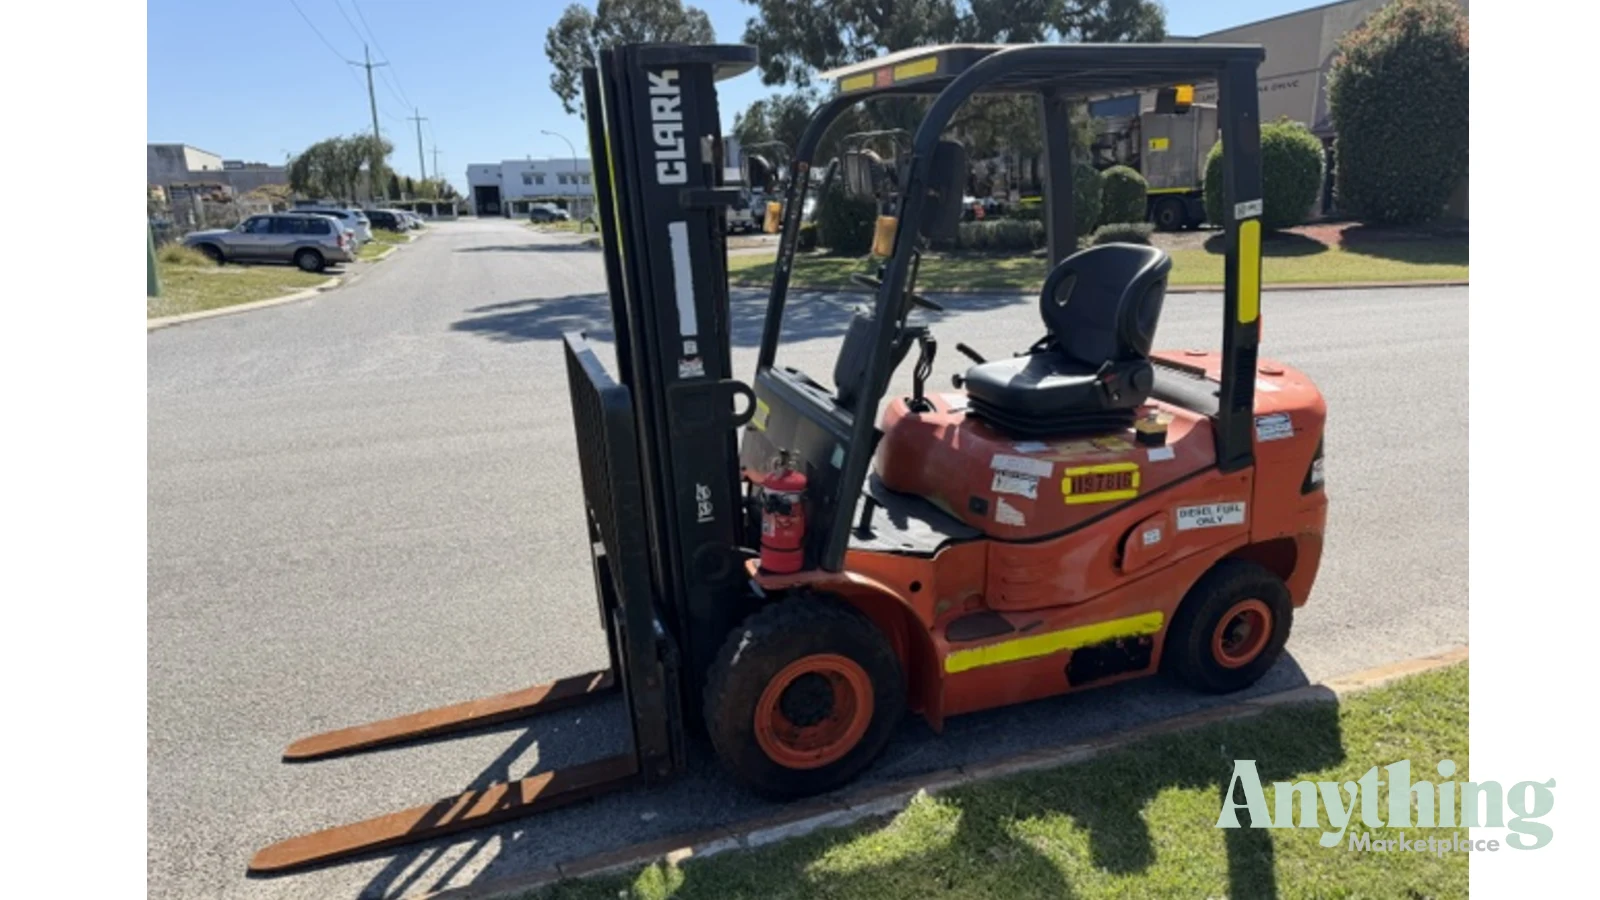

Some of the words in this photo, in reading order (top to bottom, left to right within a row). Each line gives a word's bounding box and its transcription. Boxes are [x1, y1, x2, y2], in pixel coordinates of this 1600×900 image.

[647, 69, 688, 185] CLARK
[1179, 506, 1212, 518] DIESEL
[1216, 503, 1242, 514] FUEL
[1196, 515, 1224, 526] ONLY
